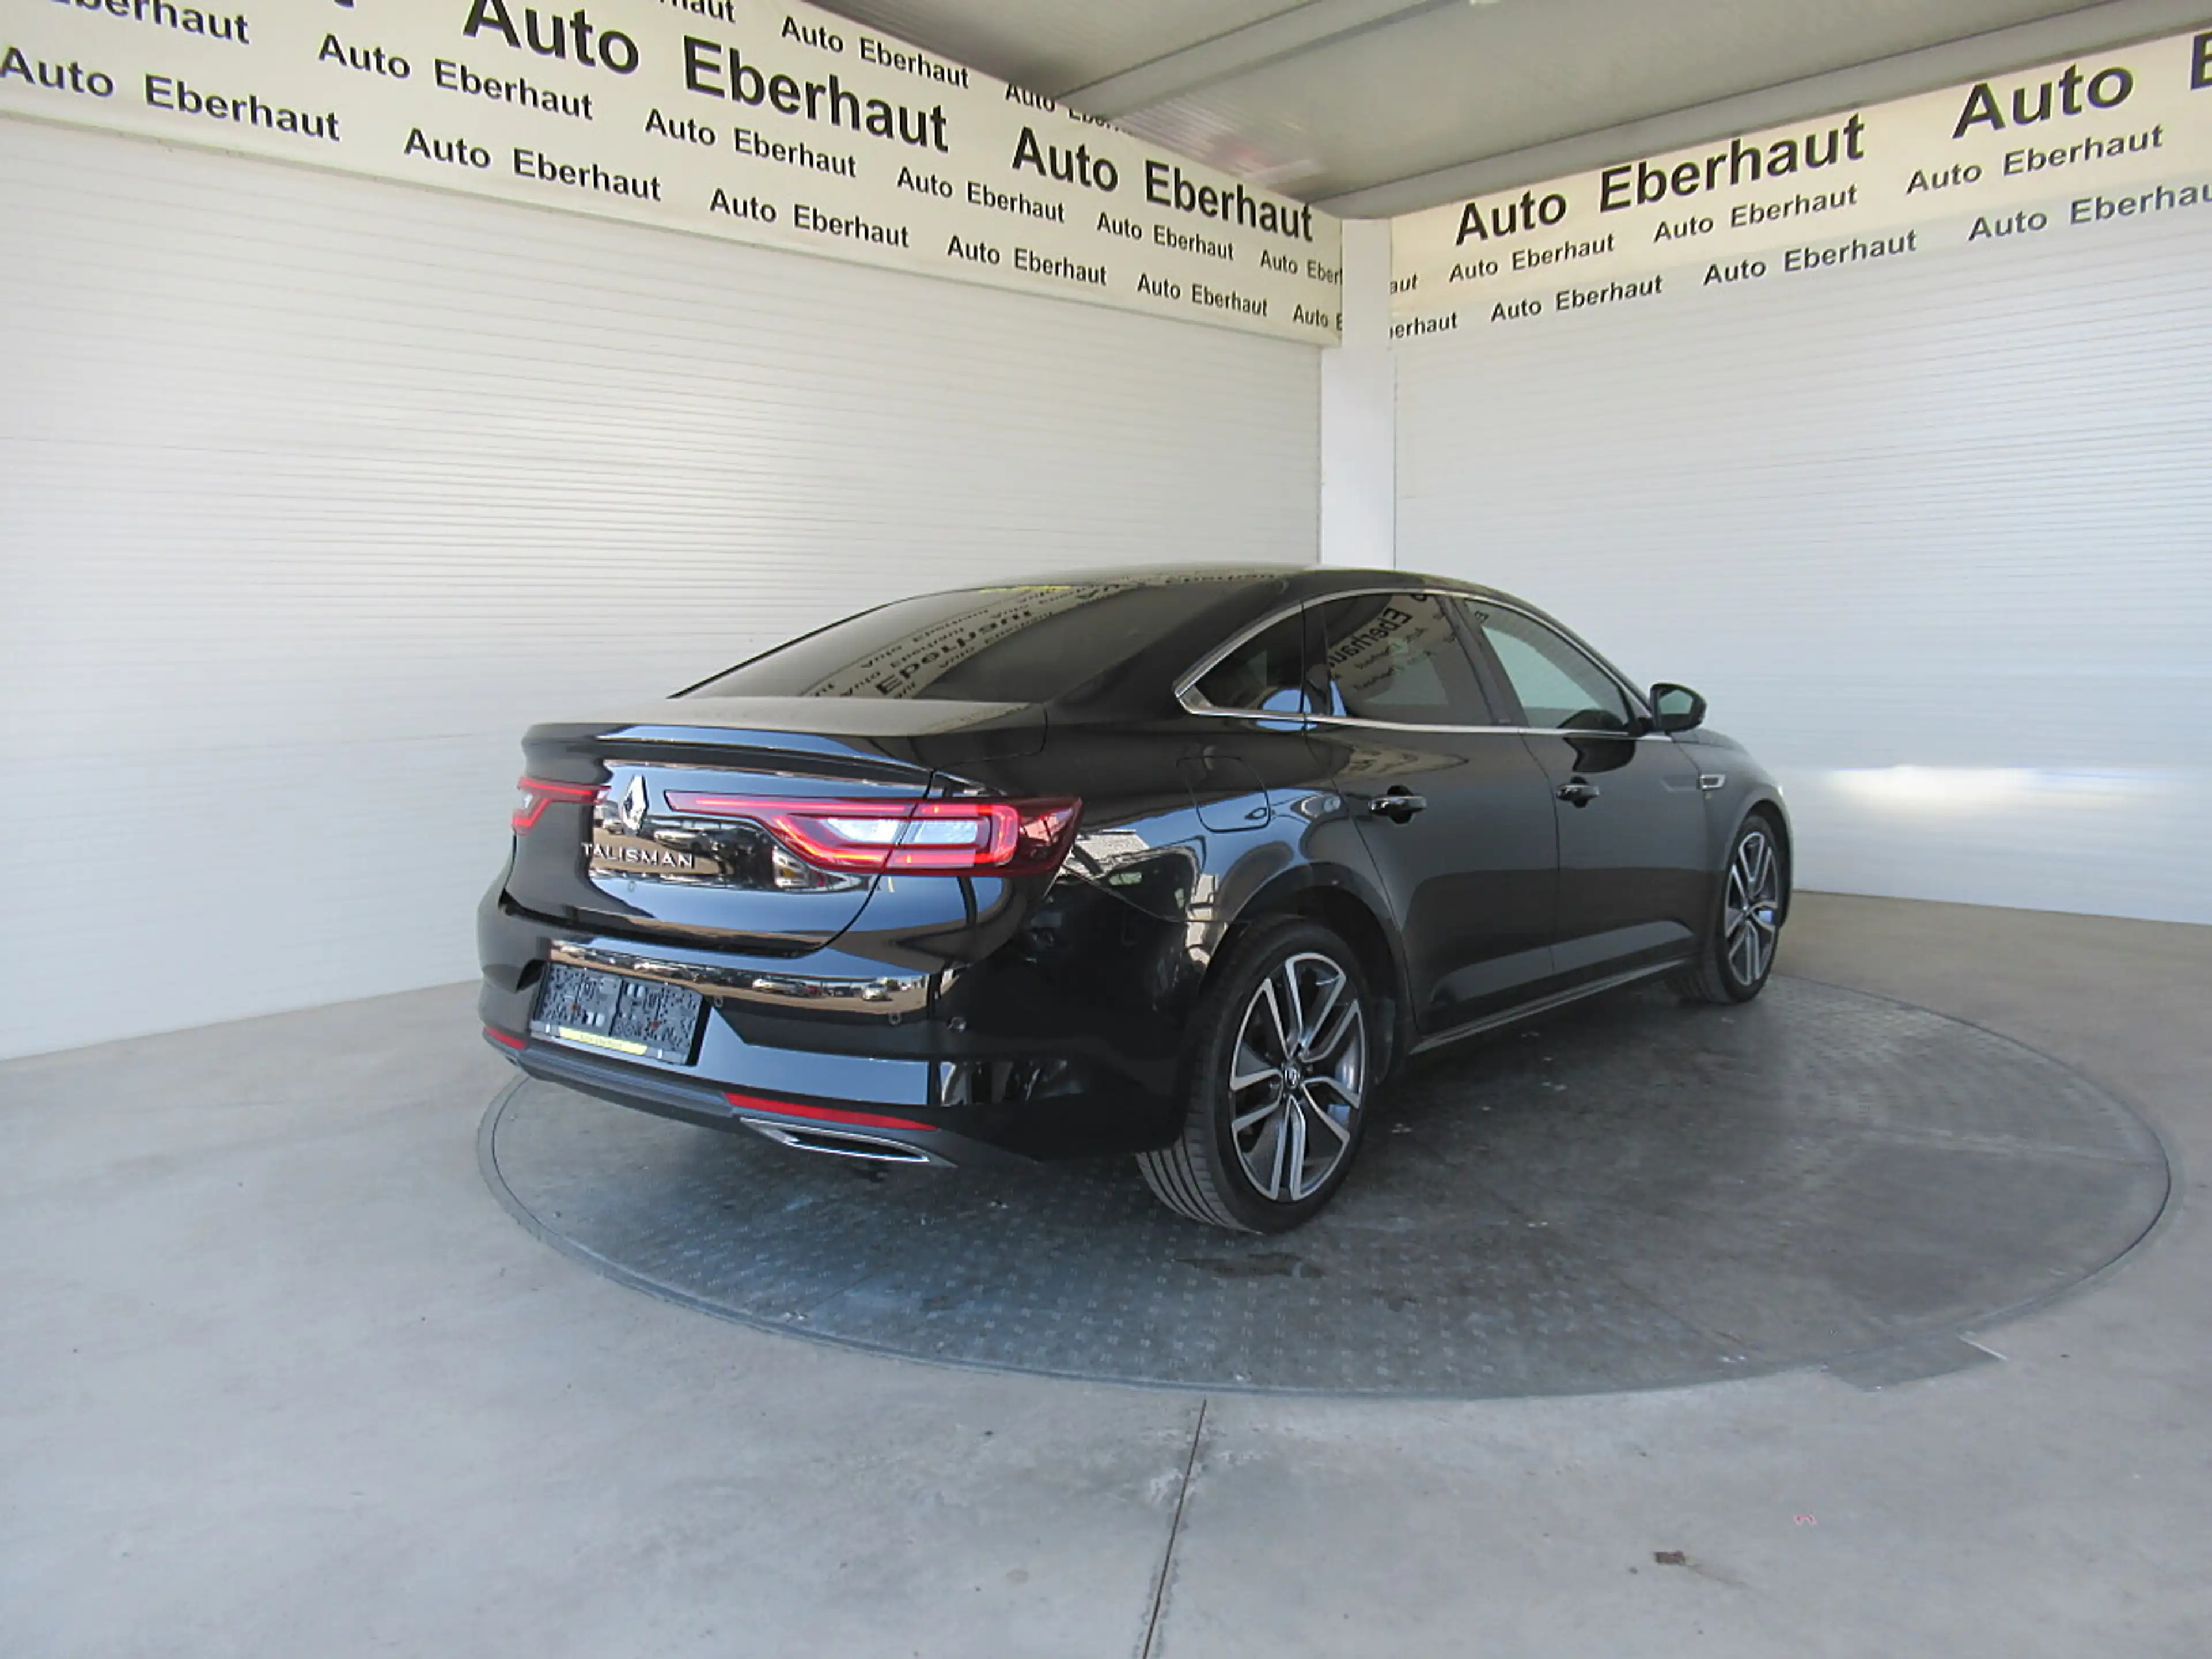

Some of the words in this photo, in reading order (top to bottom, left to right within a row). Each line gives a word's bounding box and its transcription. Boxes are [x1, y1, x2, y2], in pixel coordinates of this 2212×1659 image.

[51, 0, 249, 44] erhaut
[319, 33, 410, 78] Auto
[435, 59, 592, 120] Eberhaut
[463, 0, 638, 74] Auto
[684, 35, 948, 153] Eberhaut
[782, 16, 843, 53] Auto
[860, 37, 968, 89] Eberhaut
[0, 47, 113, 97] Auto
[146, 74, 339, 141] Eberhaut
[1952, 65, 2133, 139] Auto
[404, 128, 490, 168] Auto
[514, 147, 661, 202] Eberhaut
[645, 108, 715, 146] Auto
[734, 127, 856, 178] Eberhaut
[1907, 164, 1982, 194] Auto
[2004, 125, 2162, 176] Eberhaut
[897, 166, 952, 198] Auto
[968, 181, 1064, 223] Eberhaut
[1012, 126, 1118, 192] Auto
[1146, 160, 1313, 242] Eberhaut
[1456, 192, 1566, 246] Auto
[1600, 115, 1864, 213] Eberhaut
[710, 188, 776, 222] Auto
[794, 204, 909, 248] Eberhaut
[1097, 212, 1142, 240] Auto
[1154, 225, 1233, 260] Eberhaut
[1654, 217, 1713, 243] Auto
[1731, 184, 1857, 228] Eberhaut
[1969, 211, 2047, 241] Auto
[948, 235, 1000, 264] Auto
[1015, 247, 1106, 286] Eberhaut
[1261, 249, 1298, 274] Auto
[1449, 260, 1498, 282] Auto
[1513, 233, 1613, 270] Eberhaut
[1704, 260, 1766, 286] Auto
[1785, 230, 1916, 272] Eberhaut
[1138, 273, 1180, 300] Auto
[1192, 283, 1267, 317] Eberhaut
[1293, 304, 1328, 328] Auto
[1491, 299, 1541, 322] Auto
[1556, 275, 1662, 310] Eberhaut
[581, 842, 695, 869] TALISMAN
